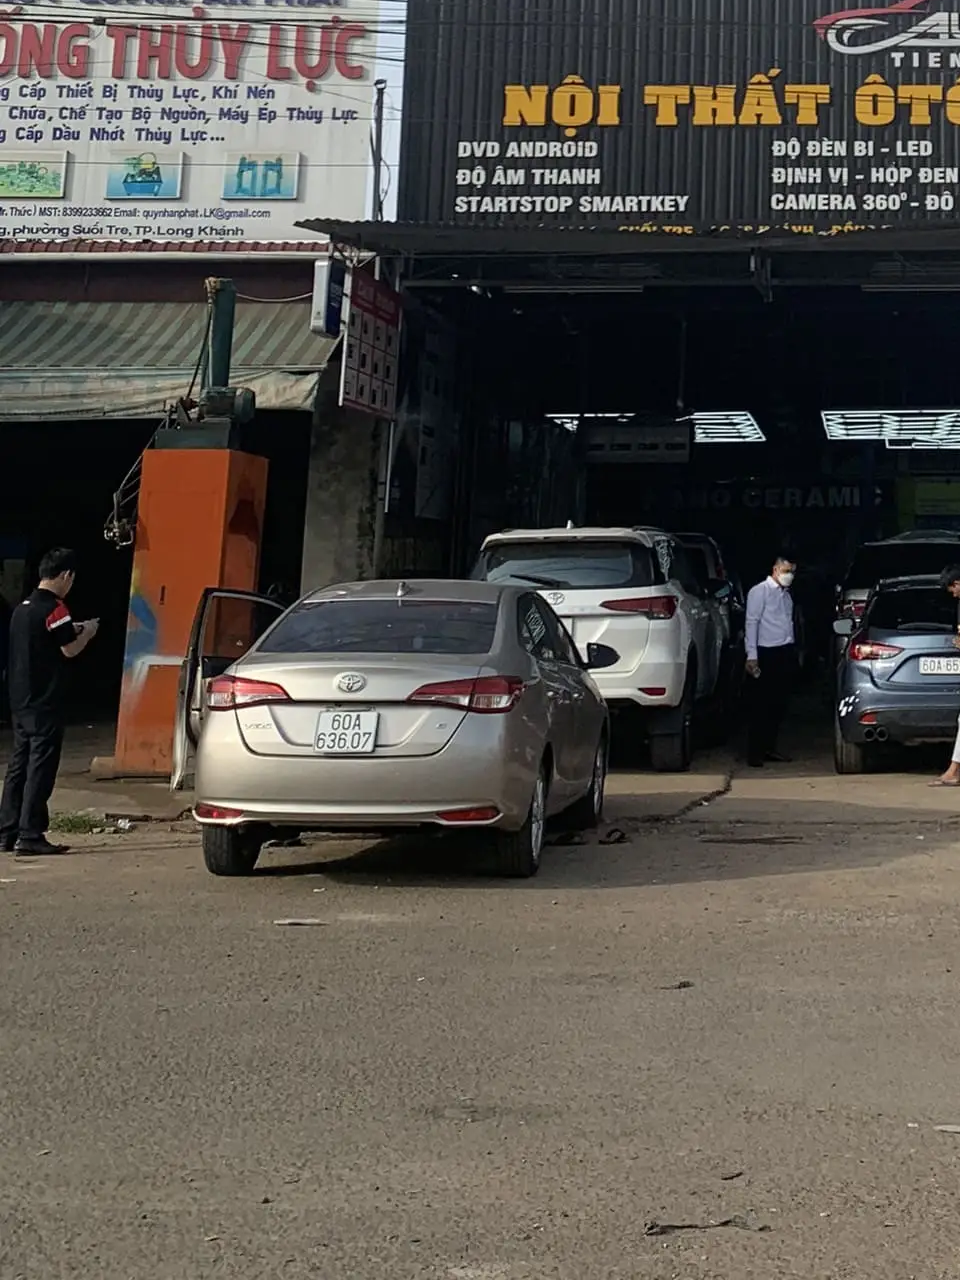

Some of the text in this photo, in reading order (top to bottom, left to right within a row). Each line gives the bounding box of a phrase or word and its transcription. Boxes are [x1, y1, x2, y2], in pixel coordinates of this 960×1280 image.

[106, 6, 250, 80] THỦY
[267, 15, 365, 93] LỰC
[19, 81, 46, 101] Cấp
[56, 81, 94, 100] Thiết
[102, 83, 118, 102] Bị
[128, 83, 164, 102] Thủy
[172, 85, 207, 103] Lực,
[212, 84, 240, 99] Khí
[247, 83, 275, 100] Nén
[503, 74, 622, 138] NỘI
[644, 68, 831, 126] THẤT
[58, 103, 90, 120] Chế
[96, 107, 123, 124] Tạo
[132, 107, 153, 125] Bộ
[218, 105, 249, 124] Máy
[258, 102, 277, 123] Ép
[286, 106, 323, 124] Thủy
[332, 107, 359, 125] Lực
[15, 123, 44, 143] Cấp
[52, 123, 80, 141] Dầu
[89, 125, 125, 141] Nhớt
[135, 126, 172, 145] Thủy
[458, 140, 599, 158] DVD ANDROID
[771, 136, 801, 160] ĐỘ
[806, 137, 847, 157] ĐÈN
[854, 140, 874, 157] BI
[896, 140, 933, 157] LED
[455, 165, 601, 189] ĐỘ ÂM THANH
[771, 167, 822, 186] ĐỊNH
[828, 167, 849, 186] VỊ
[918, 167, 959, 184] ĐEN
[39, 206, 61, 217] MST:
[455, 195, 690, 213] STARTSTOP SMARTKEY
[770, 194, 857, 211] CAMERA
[72, 221, 103, 236] Suối
[106, 224, 132, 236] Tre,
[198, 224, 245, 236] Khánh
[331, 713, 361, 731] 60A
[316, 732, 372, 750] 636.07
